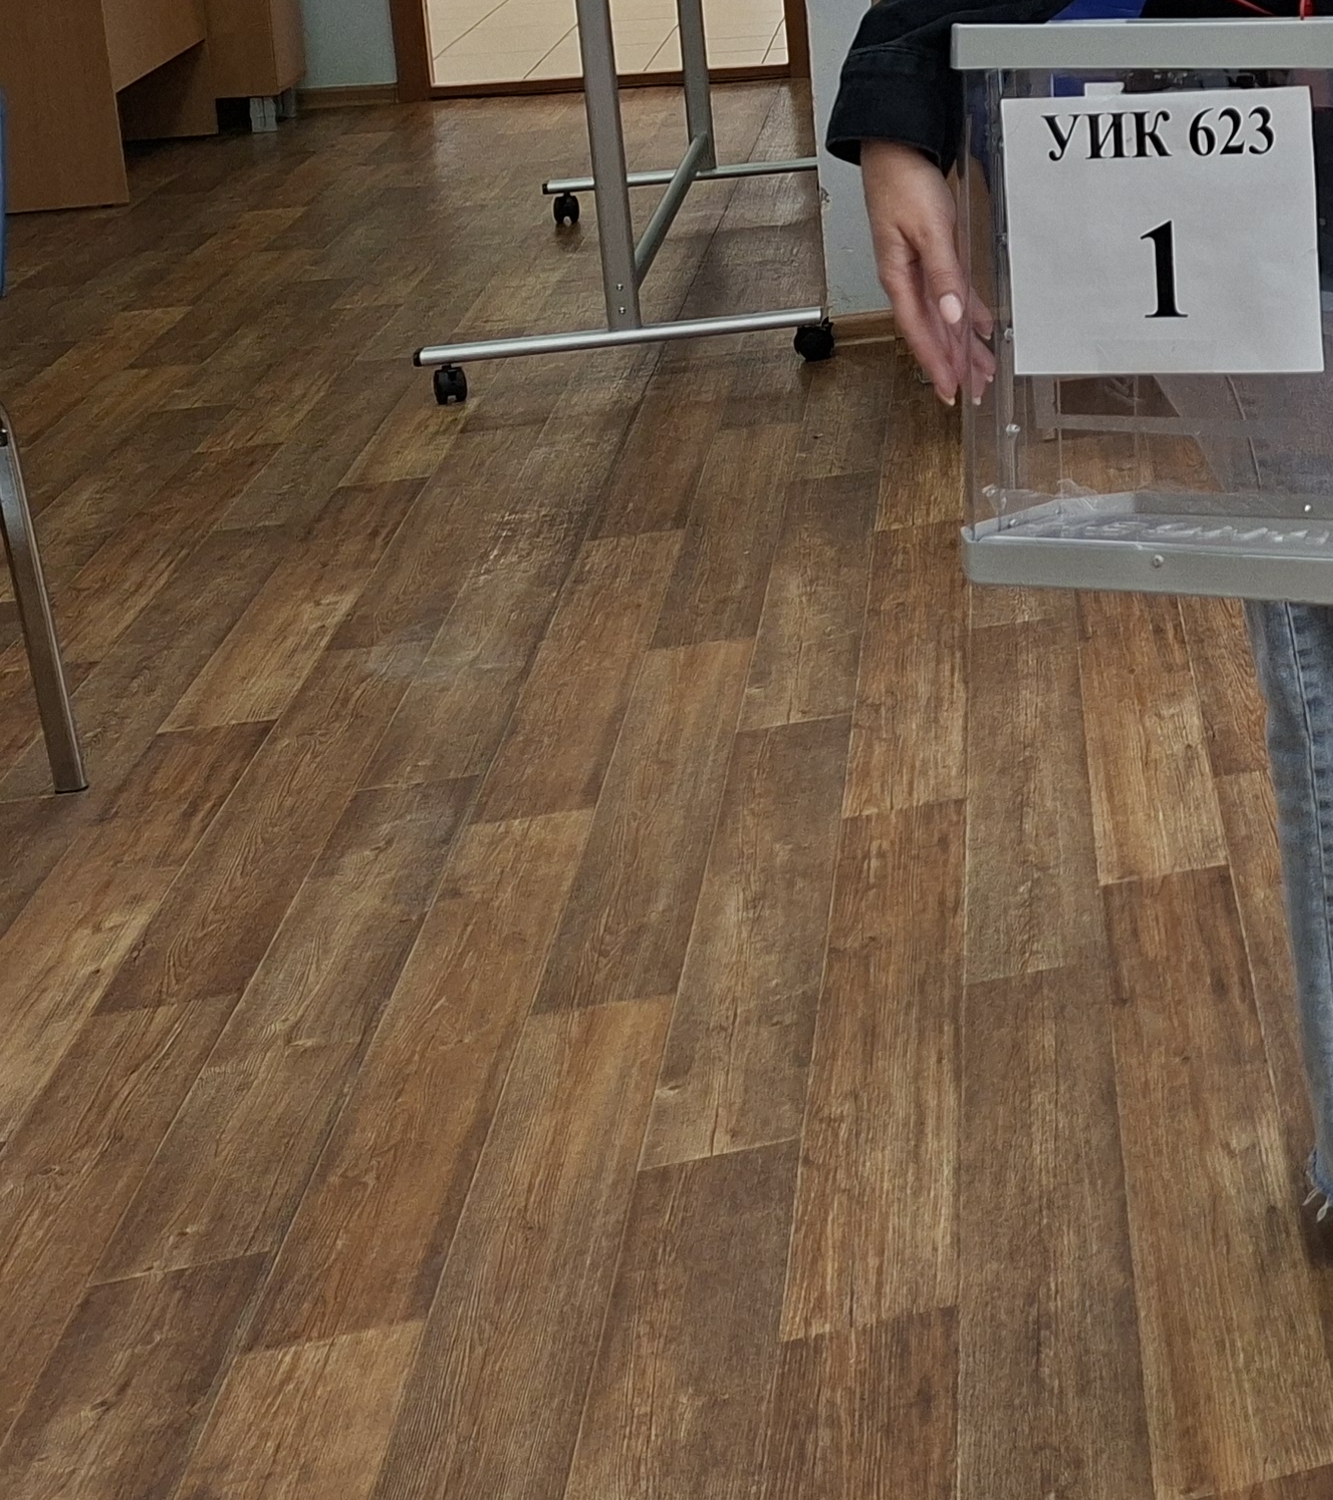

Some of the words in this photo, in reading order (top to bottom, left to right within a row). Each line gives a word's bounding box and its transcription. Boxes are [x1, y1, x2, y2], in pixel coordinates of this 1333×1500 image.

[1041, 109, 1173, 161] УИК
[1189, 106, 1275, 157] 623
[1140, 220, 1188, 318] 1
